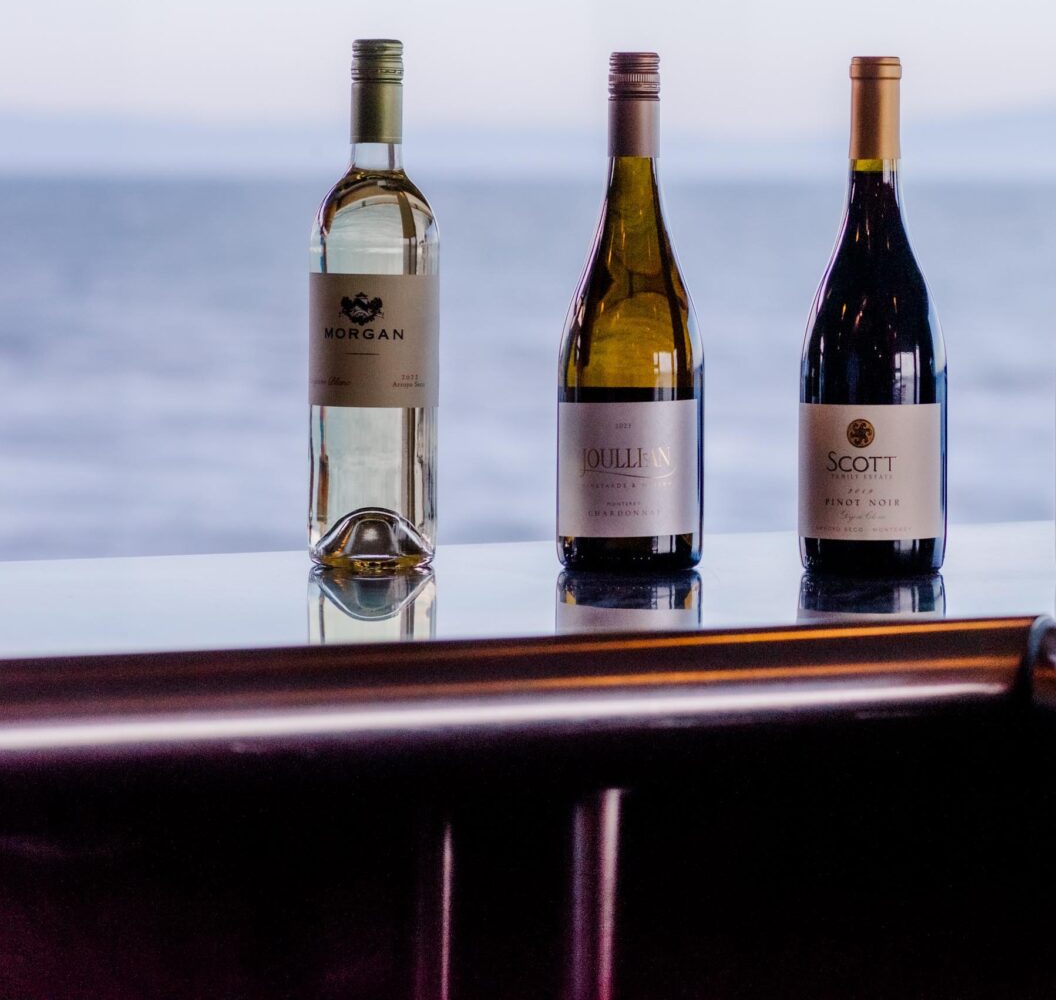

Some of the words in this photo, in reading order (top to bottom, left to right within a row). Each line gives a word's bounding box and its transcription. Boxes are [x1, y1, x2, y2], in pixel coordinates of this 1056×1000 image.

[324, 327, 404, 340] MORGAN
[825, 498, 860, 507] PINOT
[868, 498, 901, 507] NOIR
